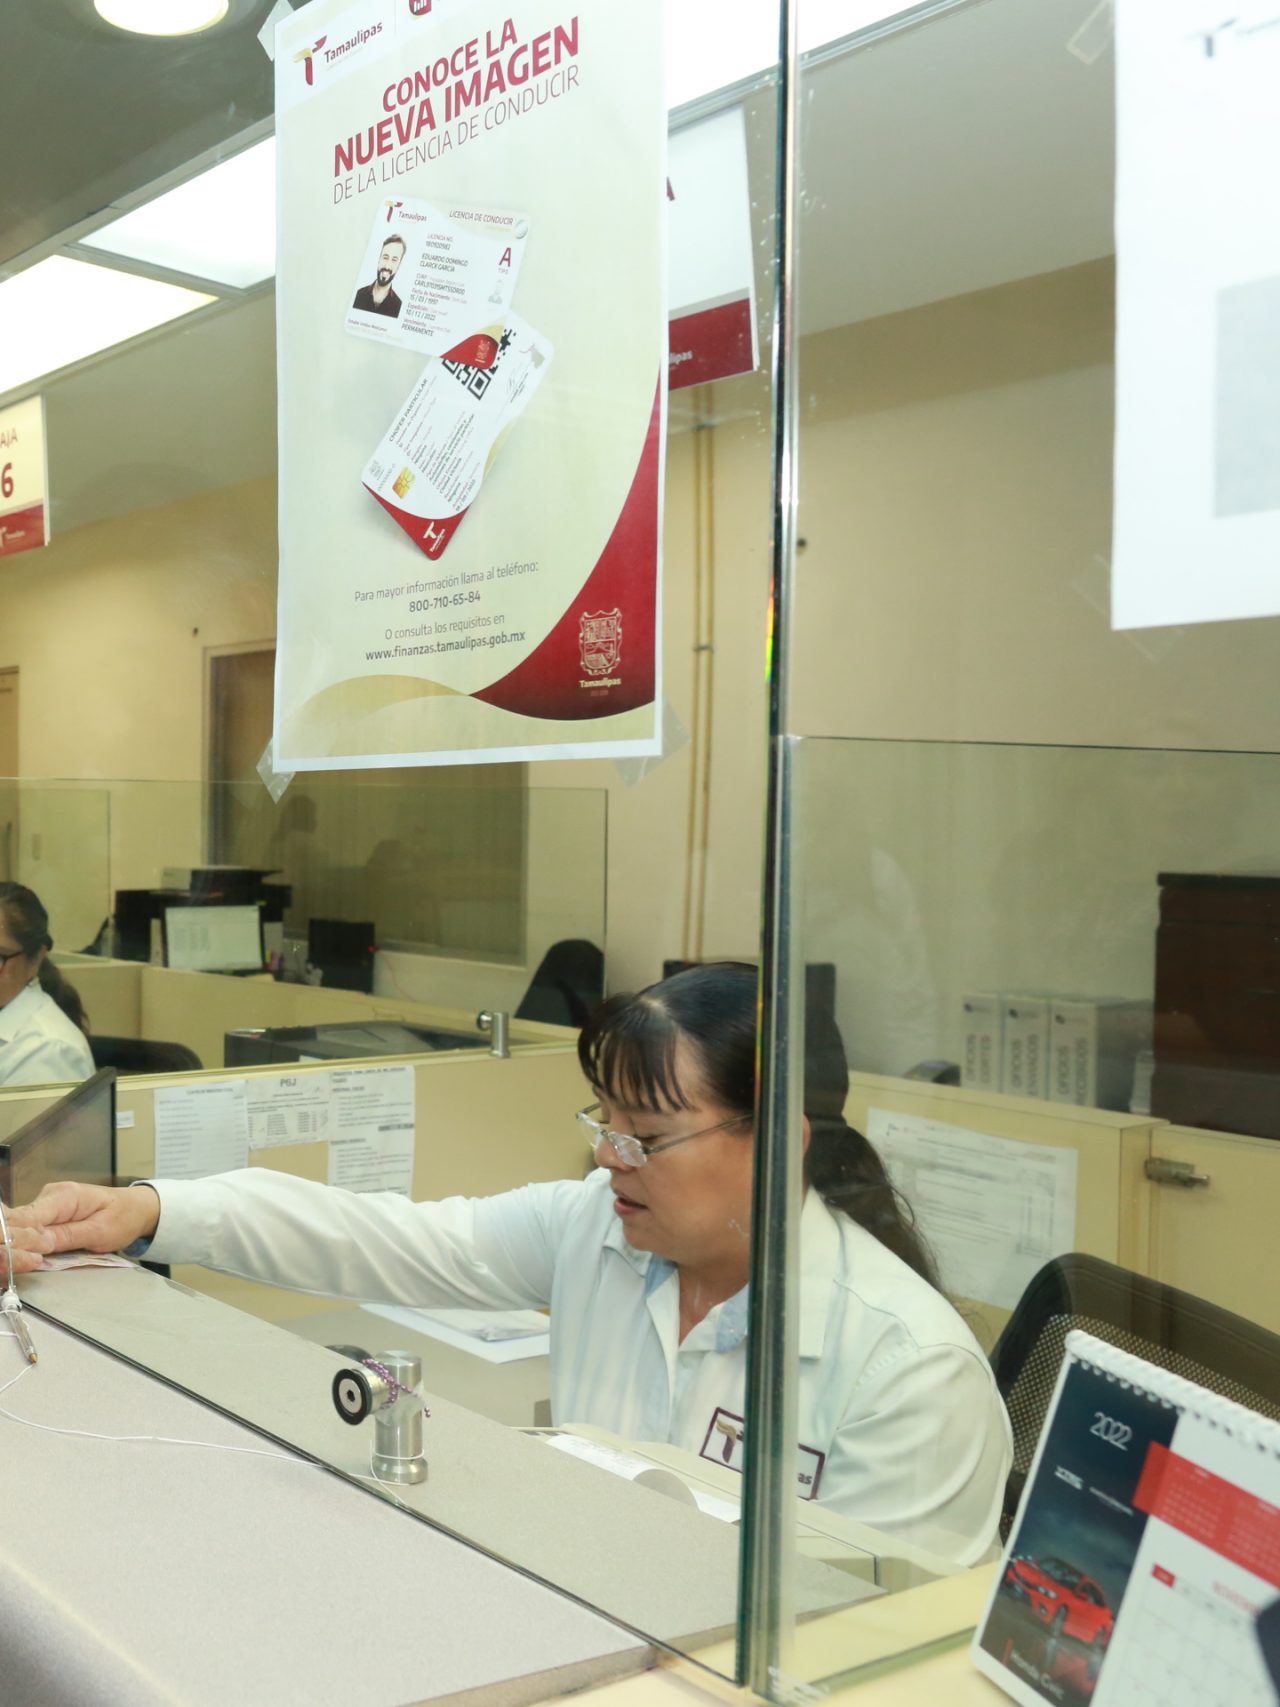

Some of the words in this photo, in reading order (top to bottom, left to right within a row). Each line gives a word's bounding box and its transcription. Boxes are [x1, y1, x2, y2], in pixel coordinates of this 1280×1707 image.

[324, 22, 383, 63] Tamaulipas
[382, 38, 479, 113] CONOCE
[486, 18, 518, 60] LA
[334, 98, 437, 177] NUEVA
[444, 16, 579, 122] IMAGEN
[333, 179, 353, 204] DE
[358, 167, 377, 194] LA
[382, 130, 452, 182] LICENCIA
[457, 116, 478, 145] DE
[484, 64, 580, 131] CONDUCIR
[398, 210, 427, 222] Tamaulipas
[449, 210, 474, 221] LICENCIA
[473, 212, 483, 222] DE
[482, 214, 514, 226] CONDUCIR
[499, 247, 512, 267] A
[1, 462, 14, 498] 6
[354, 588, 375, 602] Para
[375, 584, 405, 601] mayor
[406, 574, 460, 595] información
[460, 569, 485, 586] llama
[486, 567, 495, 581] al
[496, 560, 539, 580] teléfono:
[408, 590, 482, 613] 800-710-65-84
[384, 628, 393, 641] O
[394, 622, 433, 640] consulta
[434, 620, 448, 635] los
[449, 614, 492, 635] requisitos
[493, 613, 505, 626] en
[365, 630, 526, 661] www.finanzas.tamaulipas.gob.mx
[578, 676, 622, 689] Tamaulipas
[1089, 1411, 1133, 1451] 2022
